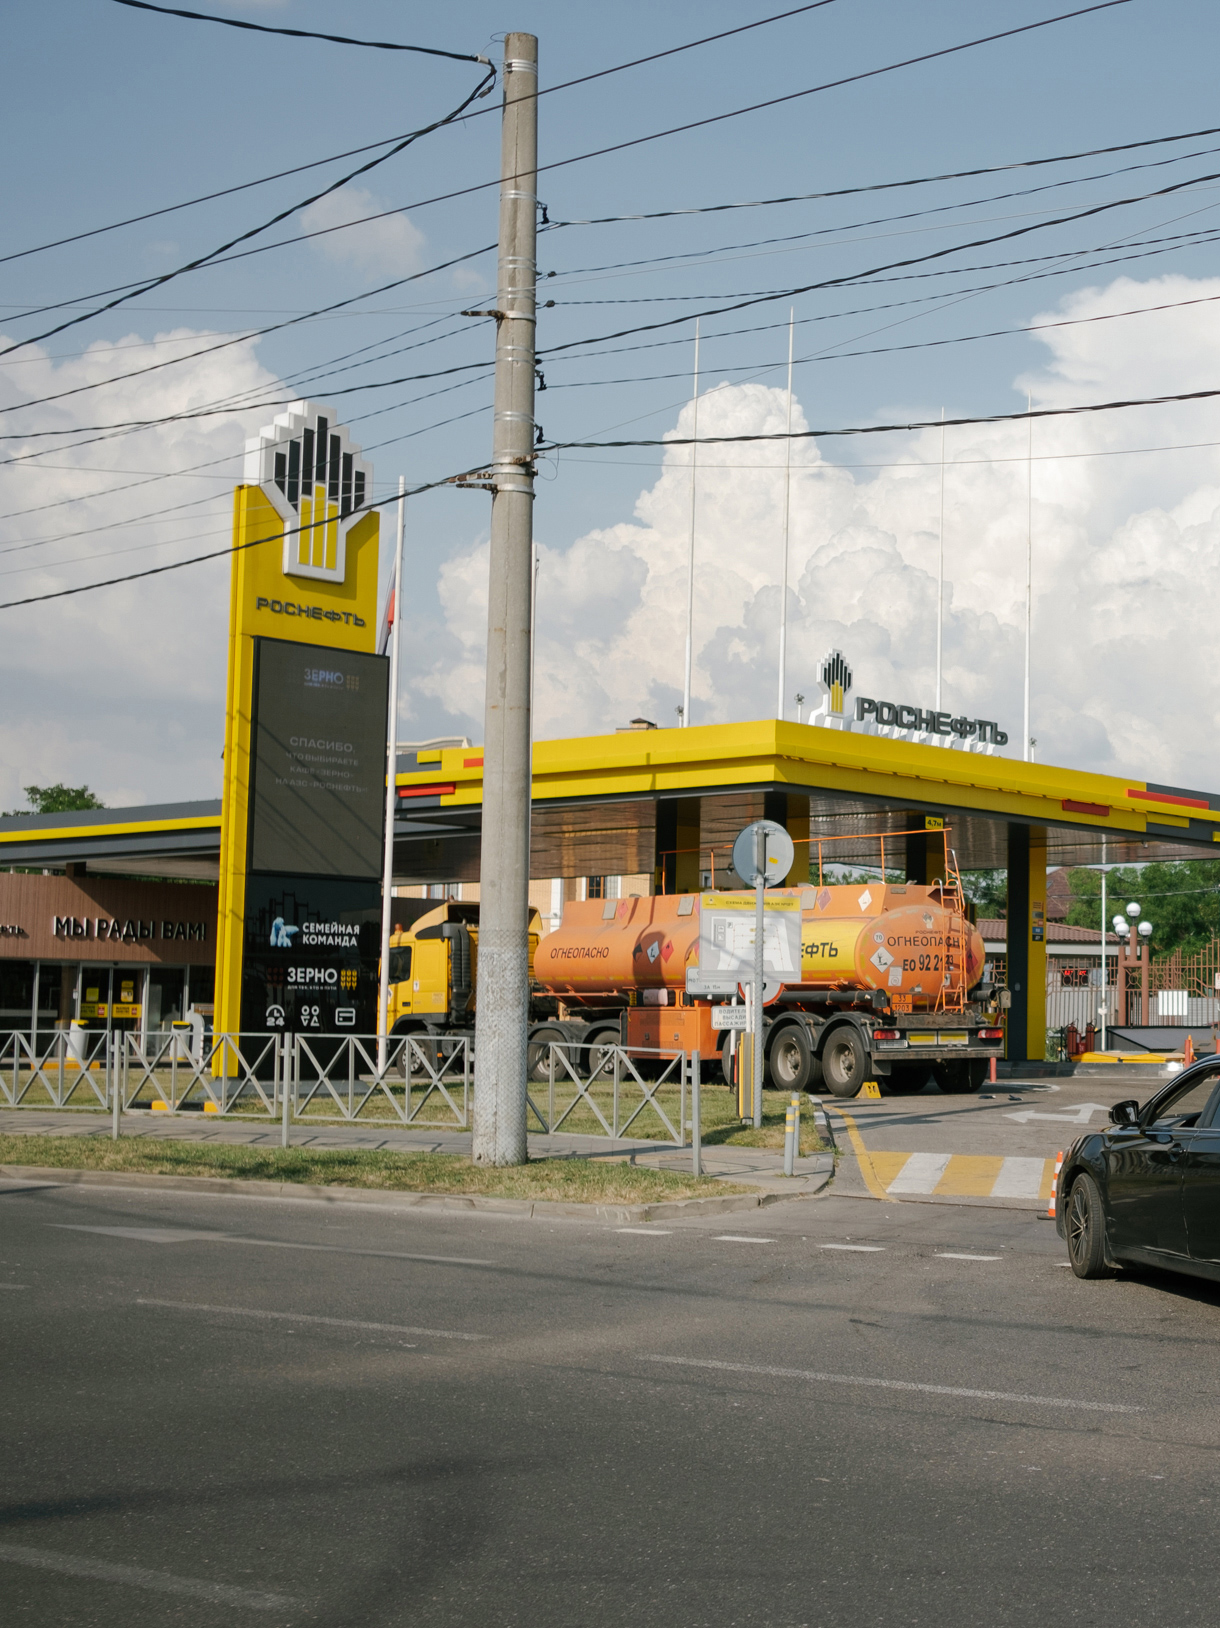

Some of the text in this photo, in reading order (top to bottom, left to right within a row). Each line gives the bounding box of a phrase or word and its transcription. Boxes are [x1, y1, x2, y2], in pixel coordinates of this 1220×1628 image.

[256, 596, 367, 627] РОСНЕФТЬ
[304, 668, 344, 684] ЗЕРНО
[854, 697, 1009, 746] РОСНЕФТЬ
[53, 915, 207, 942] МЫ РАДЫ ВАМ!
[302, 922, 360, 935] СЕМЕЙНАЯ
[302, 934, 358, 948] КОМАНДА
[550, 947, 610, 959] ОГНЕОПАСНО
[903, 959, 917, 972] ЕО
[918, 954, 931, 971] 92
[287, 966, 338, 984] ЗЕРНО
[894, 1004, 910, 1012] 1203
[266, 1017, 285, 1027] 24
